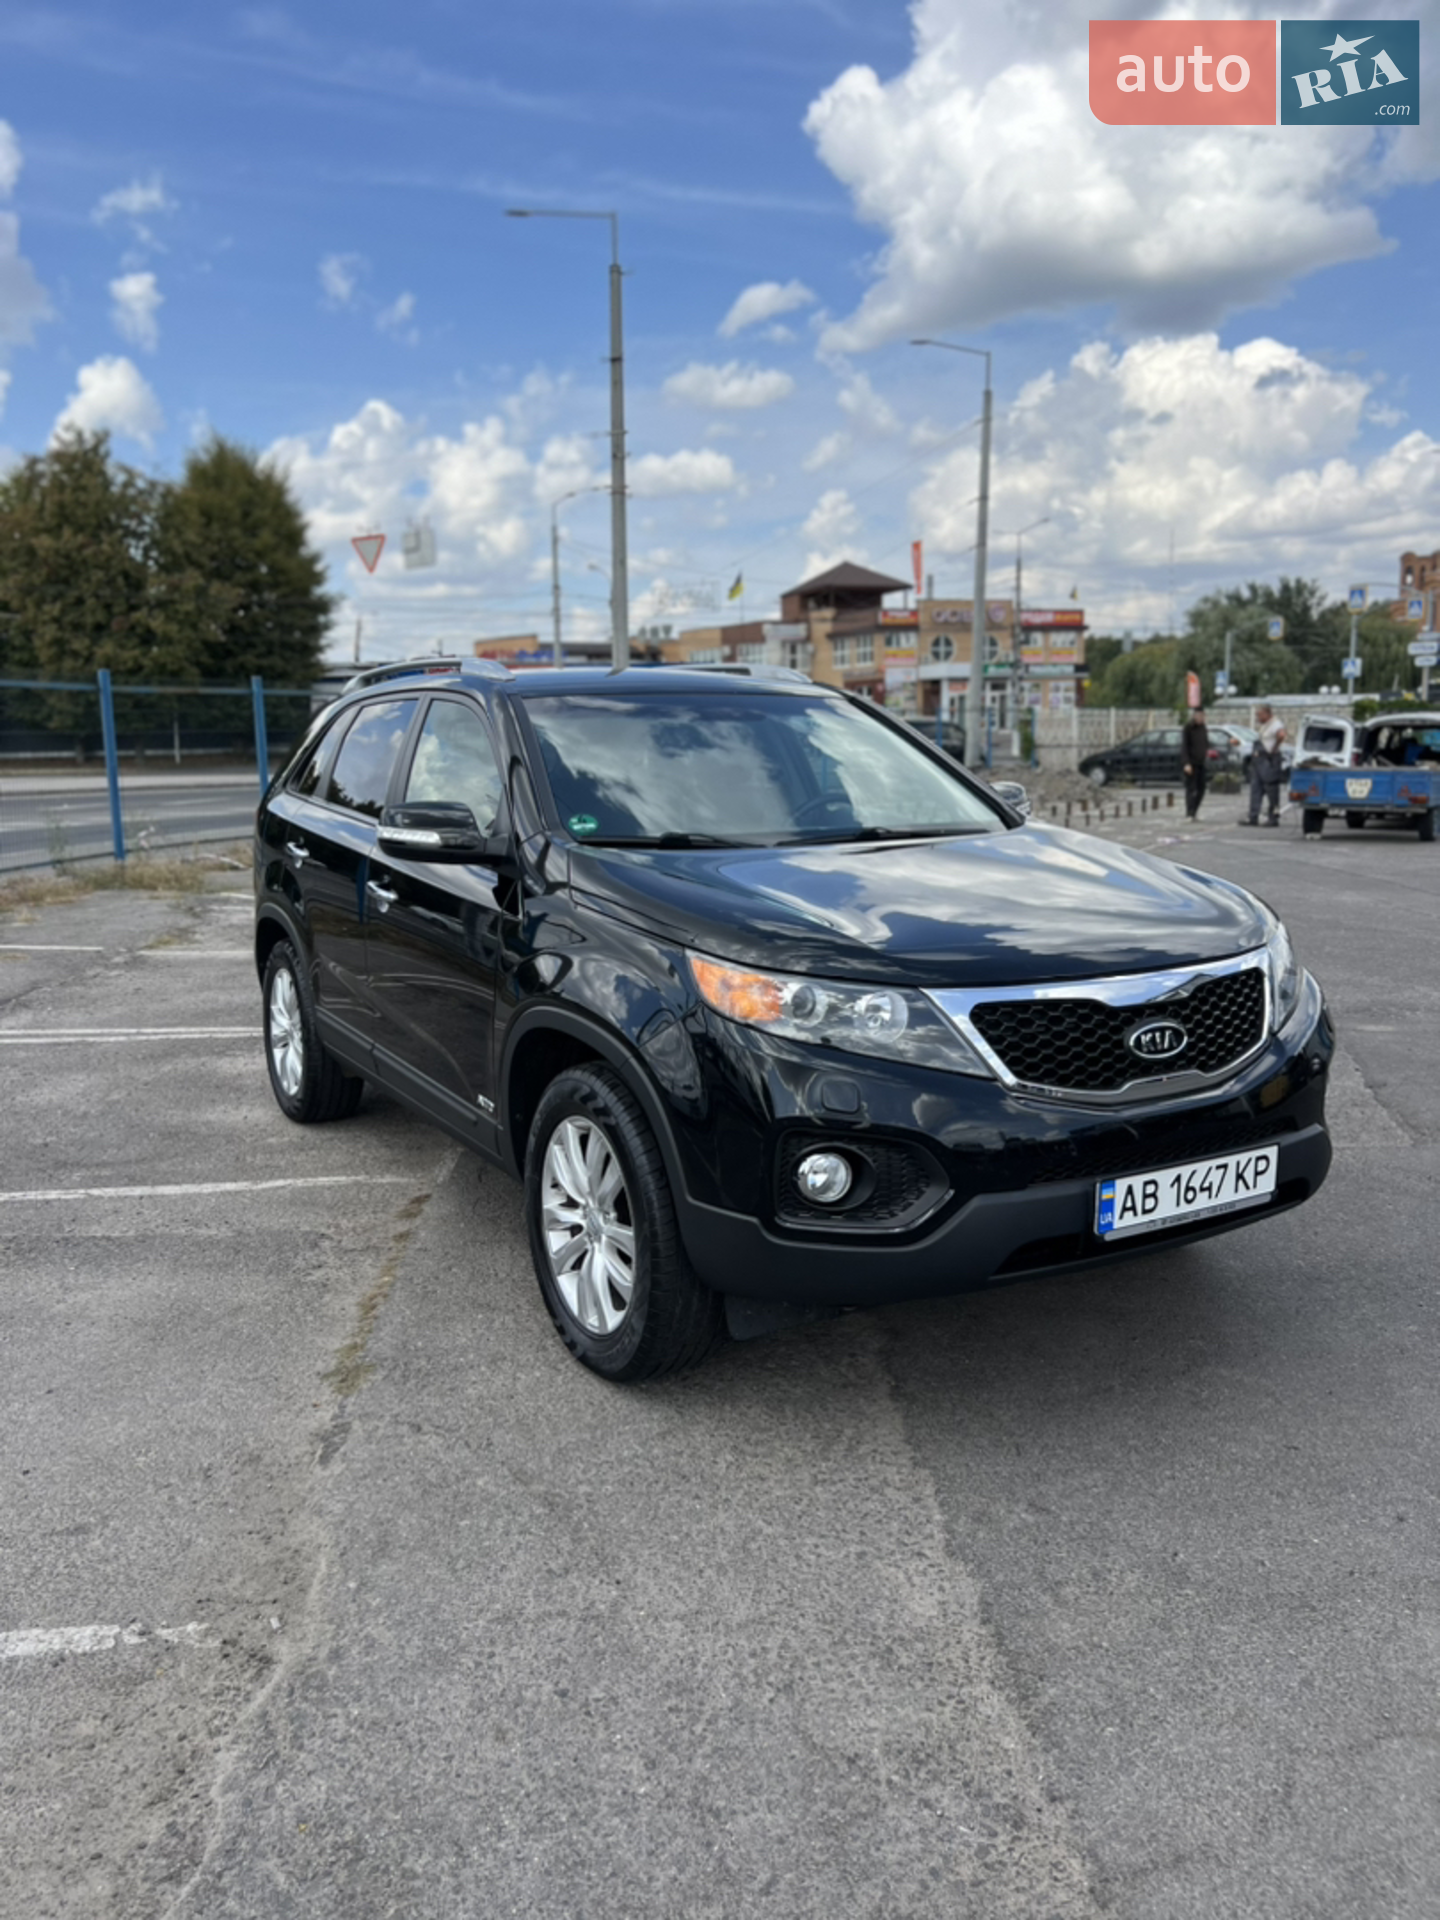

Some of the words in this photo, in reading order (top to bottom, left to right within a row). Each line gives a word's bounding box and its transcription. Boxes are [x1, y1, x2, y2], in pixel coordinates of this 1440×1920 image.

[1141, 1030, 1177, 1053] KIA
[1119, 1180, 1159, 1220] AB
[1170, 1163, 1229, 1208] 1647
[1234, 1155, 1271, 1194] KP
[1099, 1212, 1113, 1224] UA
